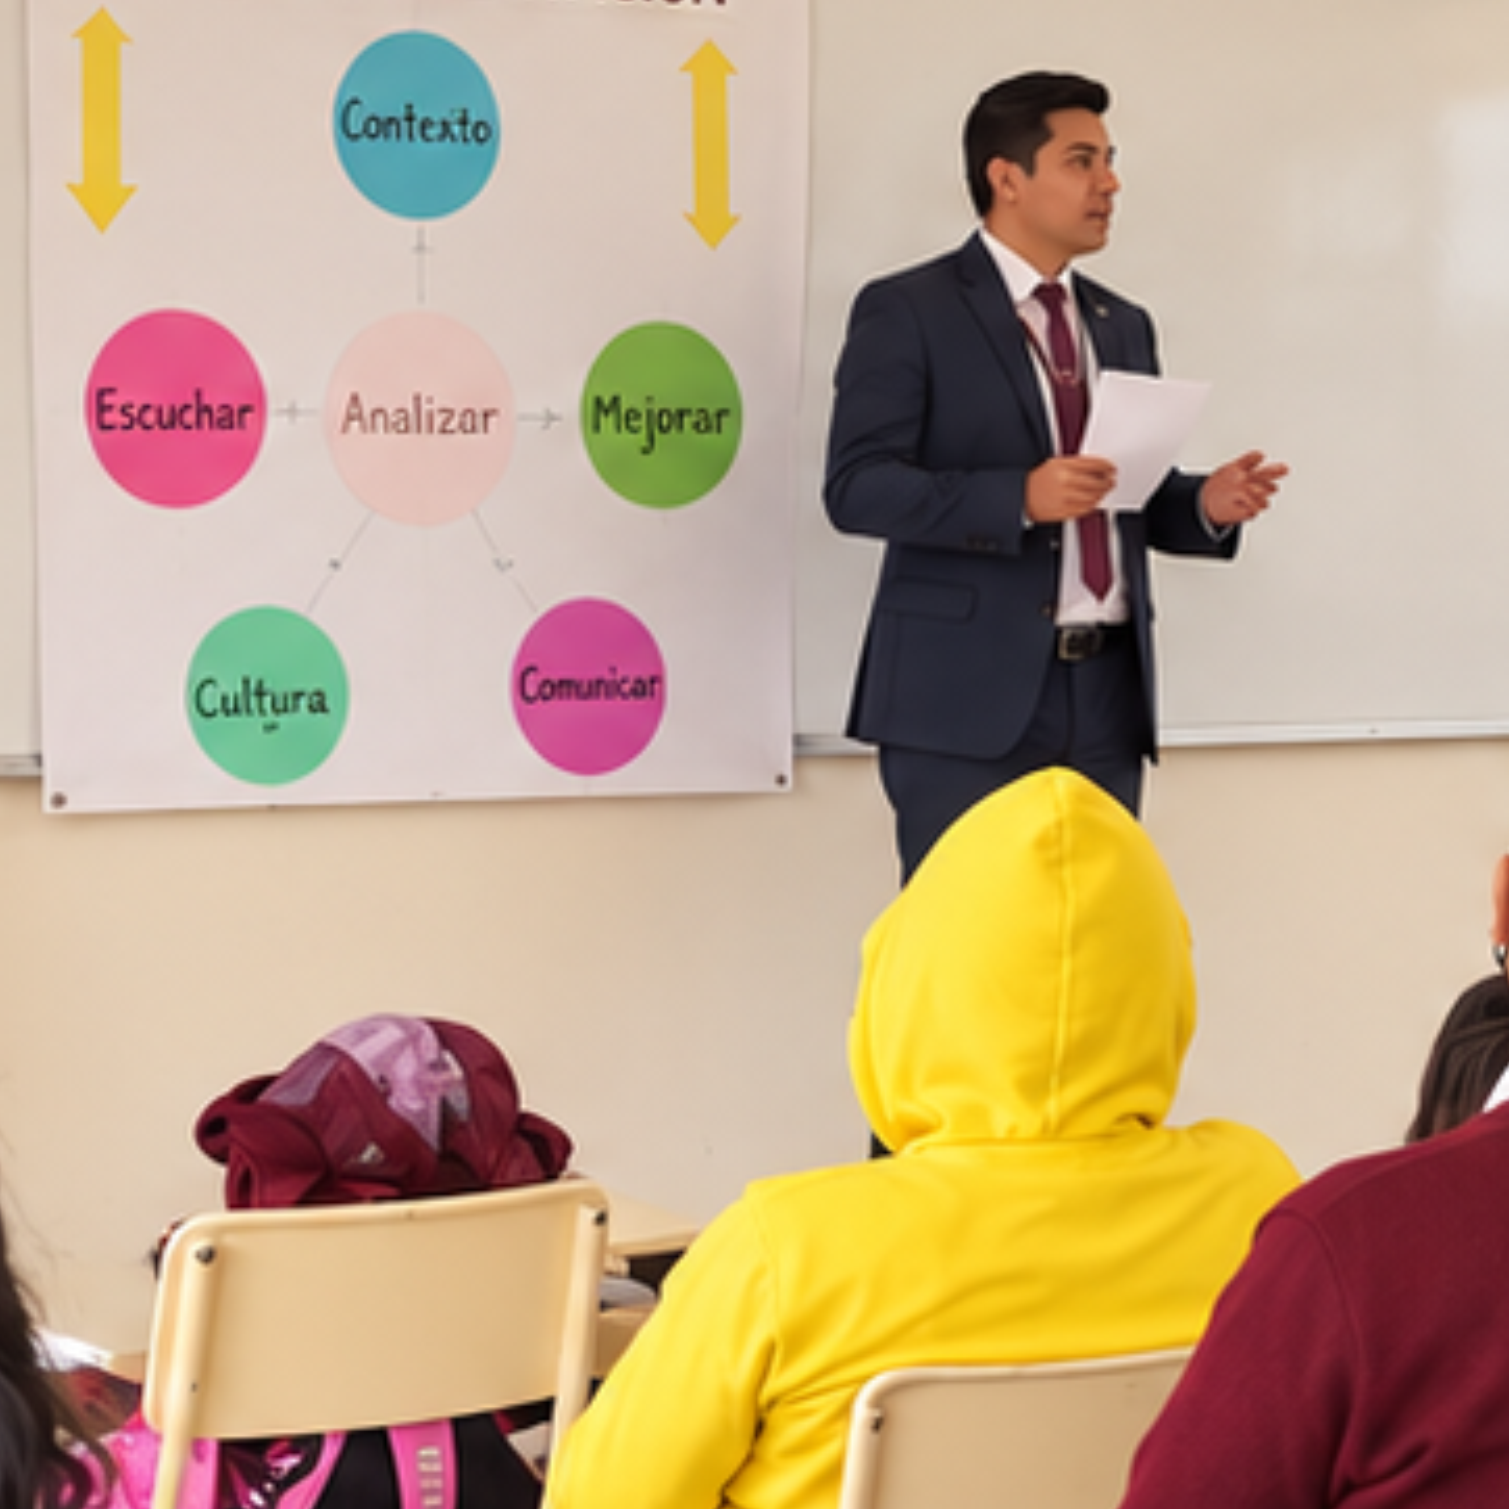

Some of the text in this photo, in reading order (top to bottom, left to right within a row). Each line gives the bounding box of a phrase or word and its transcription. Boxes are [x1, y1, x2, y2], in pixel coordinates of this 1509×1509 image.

[340, 97, 493, 146] Contexto
[95, 386, 255, 432] Escuchar
[341, 392, 500, 436] Analizar
[592, 394, 731, 456] Mejorar
[194, 676, 330, 719] Cultura
[518, 664, 663, 705] Comunicar
